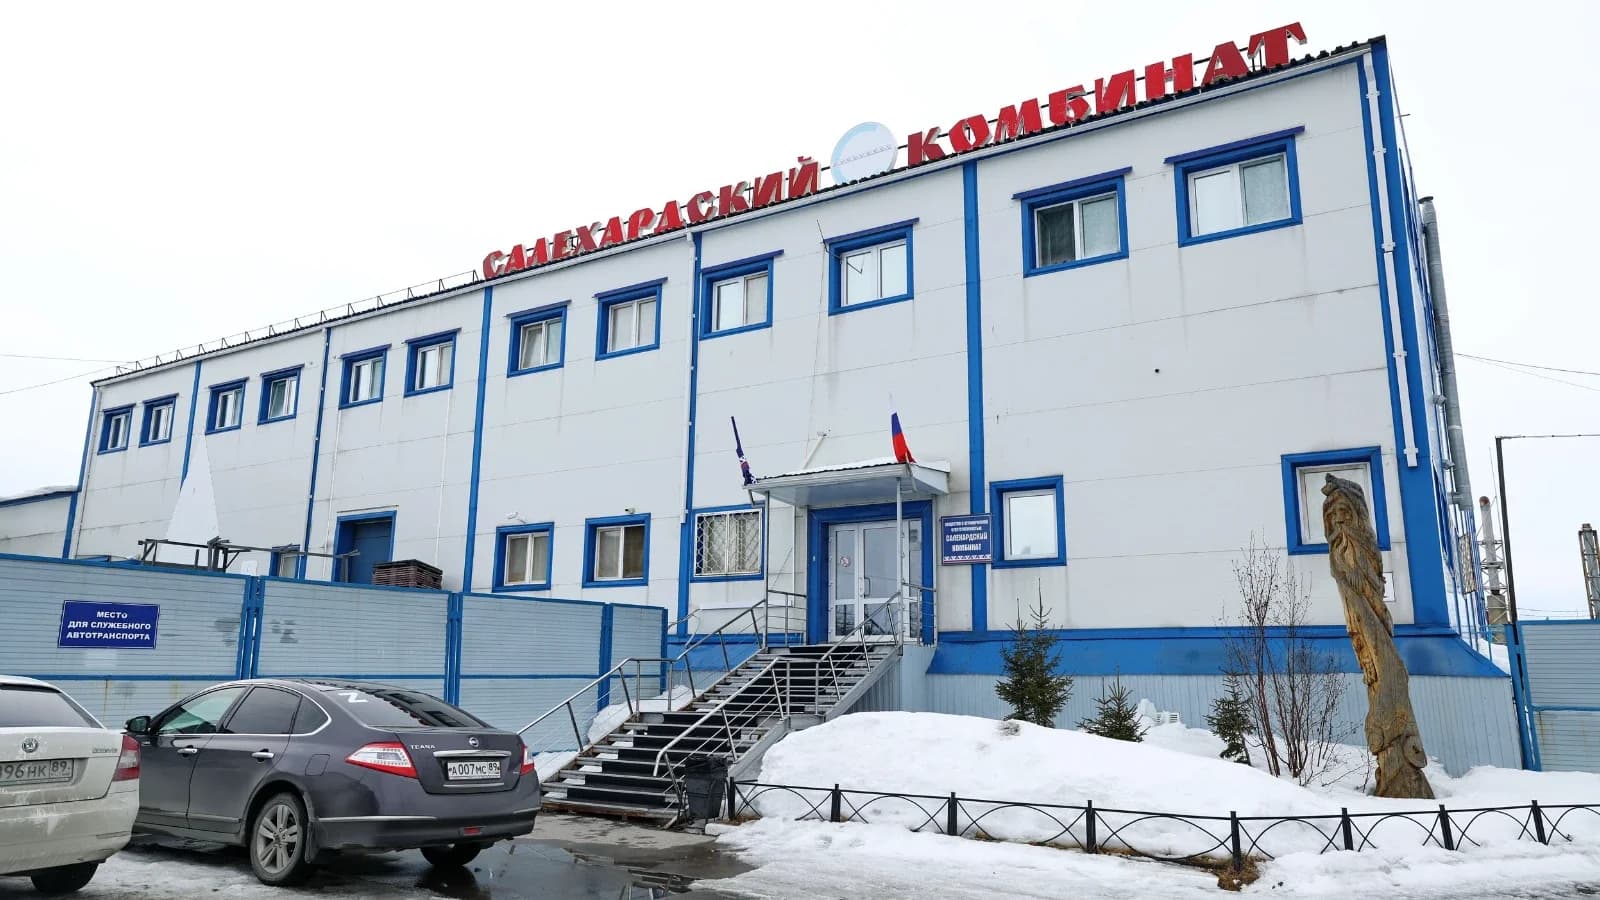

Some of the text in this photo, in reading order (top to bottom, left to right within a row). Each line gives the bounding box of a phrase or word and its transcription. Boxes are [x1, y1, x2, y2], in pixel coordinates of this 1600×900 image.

[482, 22, 1308, 281] САЛЕХАРДСКИЙ КОМБИНАТ
[96, 611, 128, 619] МЕСТО
[67, 621, 151, 630] ДЛЯ СЛУЖЕБНОГО
[66, 631, 150, 641] АВТОТРАНСПОРТА
[0, 763, 47, 779] 96НК
